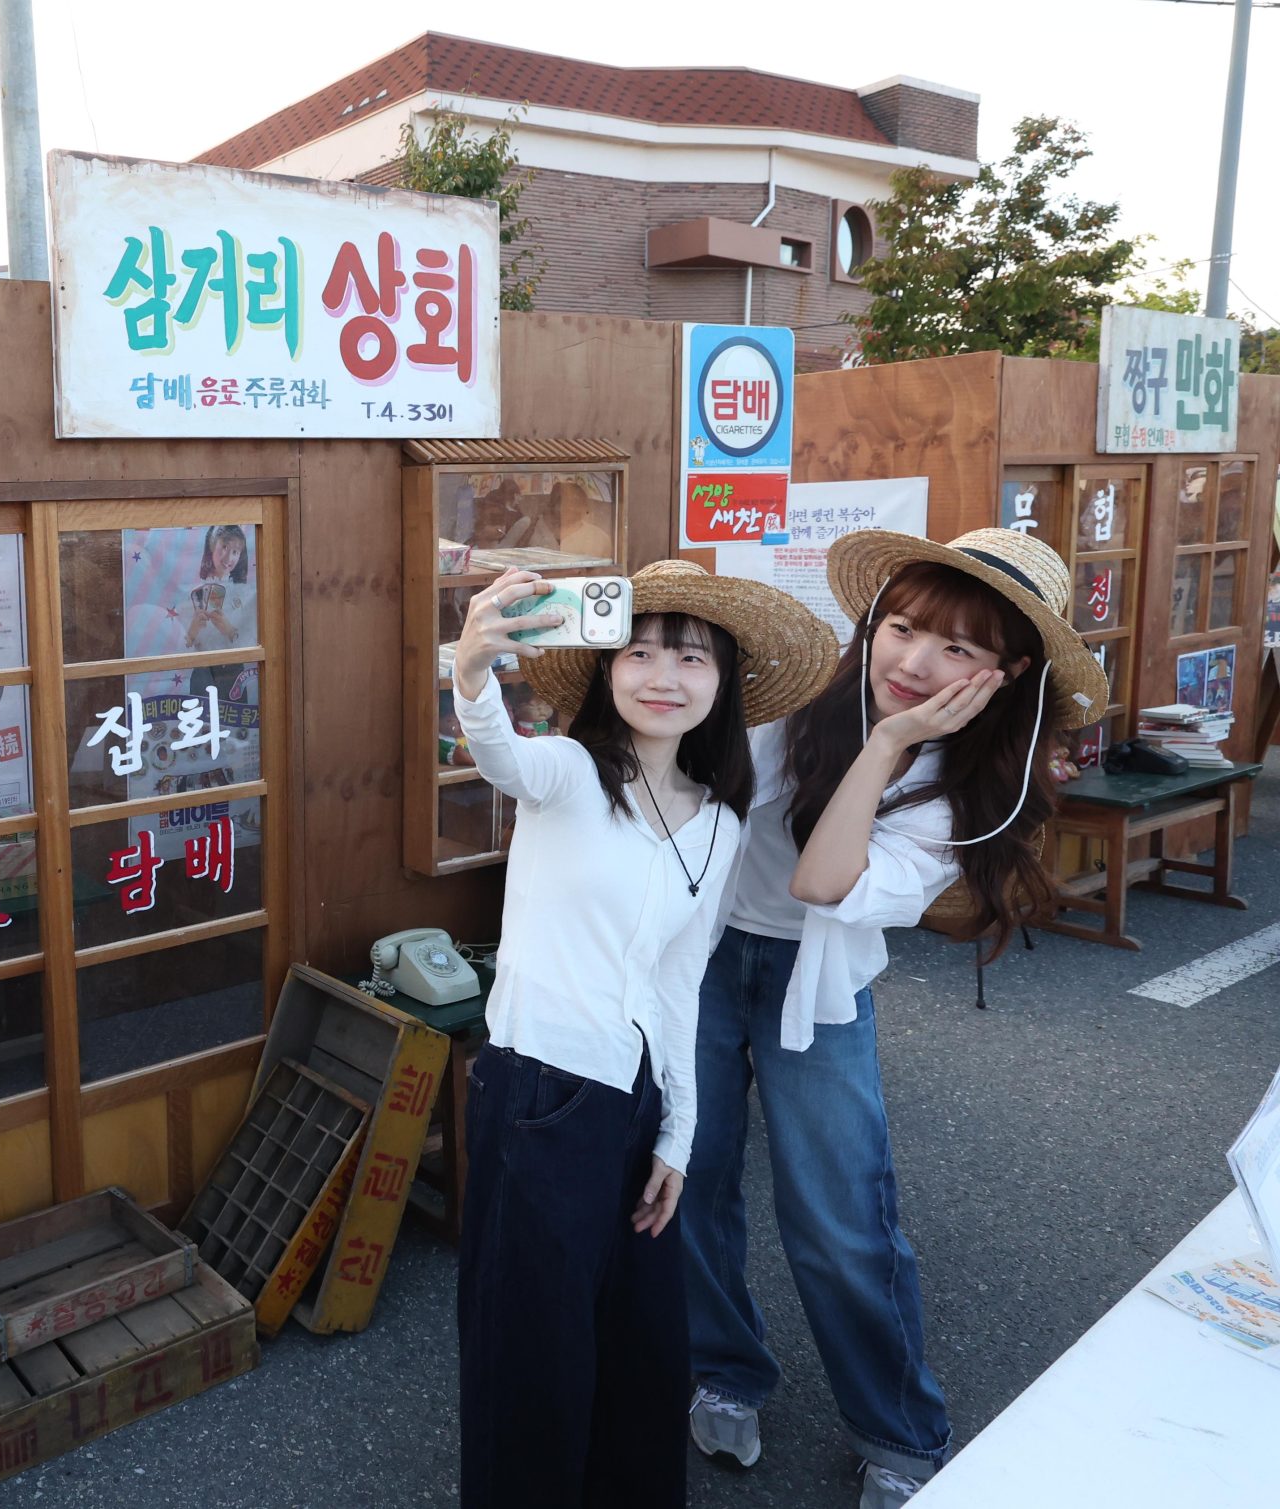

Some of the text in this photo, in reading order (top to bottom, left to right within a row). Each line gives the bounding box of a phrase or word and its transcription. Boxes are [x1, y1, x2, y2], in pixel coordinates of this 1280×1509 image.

[102, 225, 476, 387] 삼거리 상회
[711, 379, 770, 421] 담배
[1123, 333, 1235, 432] 짱구 만화
[715, 424, 763, 435] CIGARETTES
[692, 483, 734, 508] 선양
[710, 507, 762, 535] 새찬
[87, 686, 231, 776] 잡화
[107, 816, 235, 914] 담배
